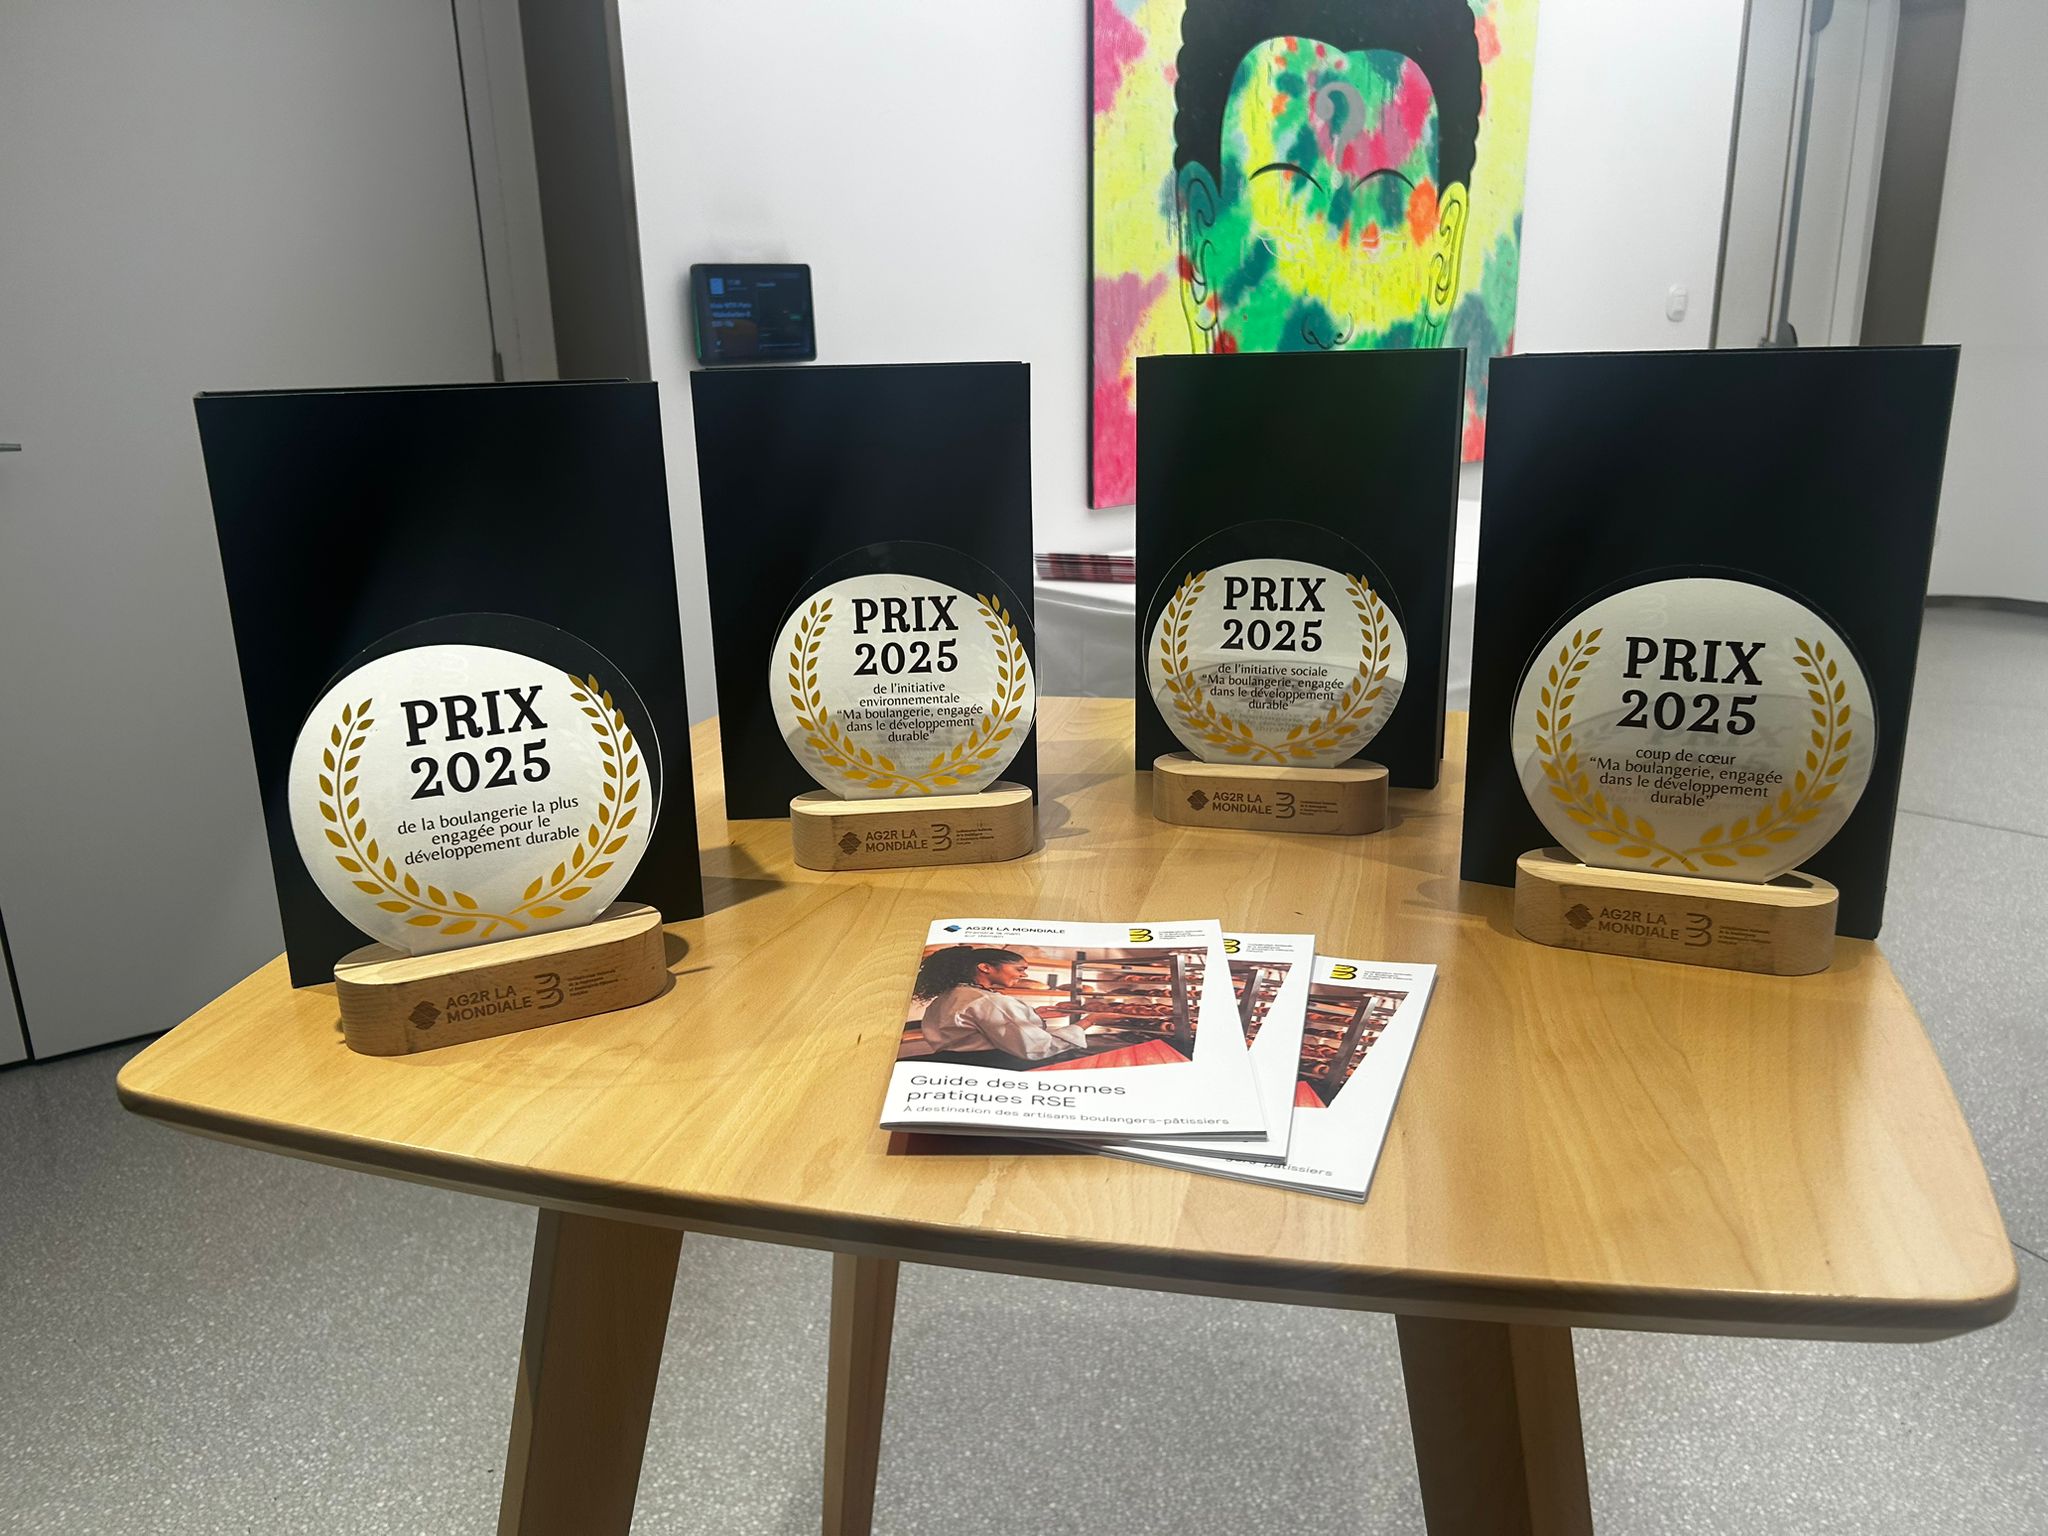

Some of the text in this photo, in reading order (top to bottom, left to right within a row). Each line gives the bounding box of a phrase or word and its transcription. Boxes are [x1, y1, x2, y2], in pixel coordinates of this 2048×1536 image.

[1223, 577, 1326, 612] PRIX
[851, 595, 959, 634] PRIX
[1220, 619, 1323, 652] 2025
[853, 638, 958, 676] 2025
[1623, 636, 1766, 686] PRIX
[1217, 663, 1231, 674] de
[1290, 666, 1328, 677] sociale
[873, 684, 887, 694] de
[1210, 686, 1334, 701] dans le développement
[1228, 675, 1295, 689] boulangerie,
[1298, 678, 1344, 692] engagée
[859, 693, 960, 707] environnementale
[400, 685, 548, 747] PRIX
[865, 706, 934, 720] boulangerie,
[937, 704, 984, 718] engagée
[1616, 689, 1757, 736] 2025
[846, 717, 975, 733] dans le développement
[1636, 749, 1736, 765] coup de cœur
[410, 738, 551, 800] 2025
[1625, 759, 1714, 780] boulangerie,
[1719, 768, 1783, 786] engagée
[1599, 773, 1769, 798] dans le développement
[1212, 792, 1263, 804] AG2R LA
[398, 797, 579, 834] de la boulangerie la plus
[1212, 802, 1273, 815] MONDIALE
[431, 815, 551, 846] engagée pour le
[866, 829, 918, 841] AG2R LA
[405, 825, 580, 865] développement durable
[865, 839, 928, 853] MONDIALE
[1599, 908, 1668, 926] AG2R LA
[1598, 921, 1680, 941] MONDIALE
[446, 985, 517, 1010] AG2R LA
[447, 996, 533, 1024] MONDIALE
[910, 1075, 1126, 1095] Guide des bonnes
[907, 1089, 1077, 1108] pratiques RSE
[916, 1105, 991, 1114] destination
[1023, 1111, 1076, 1120] artisans
[1080, 1114, 1230, 1126] boulangers-pâtissiers
